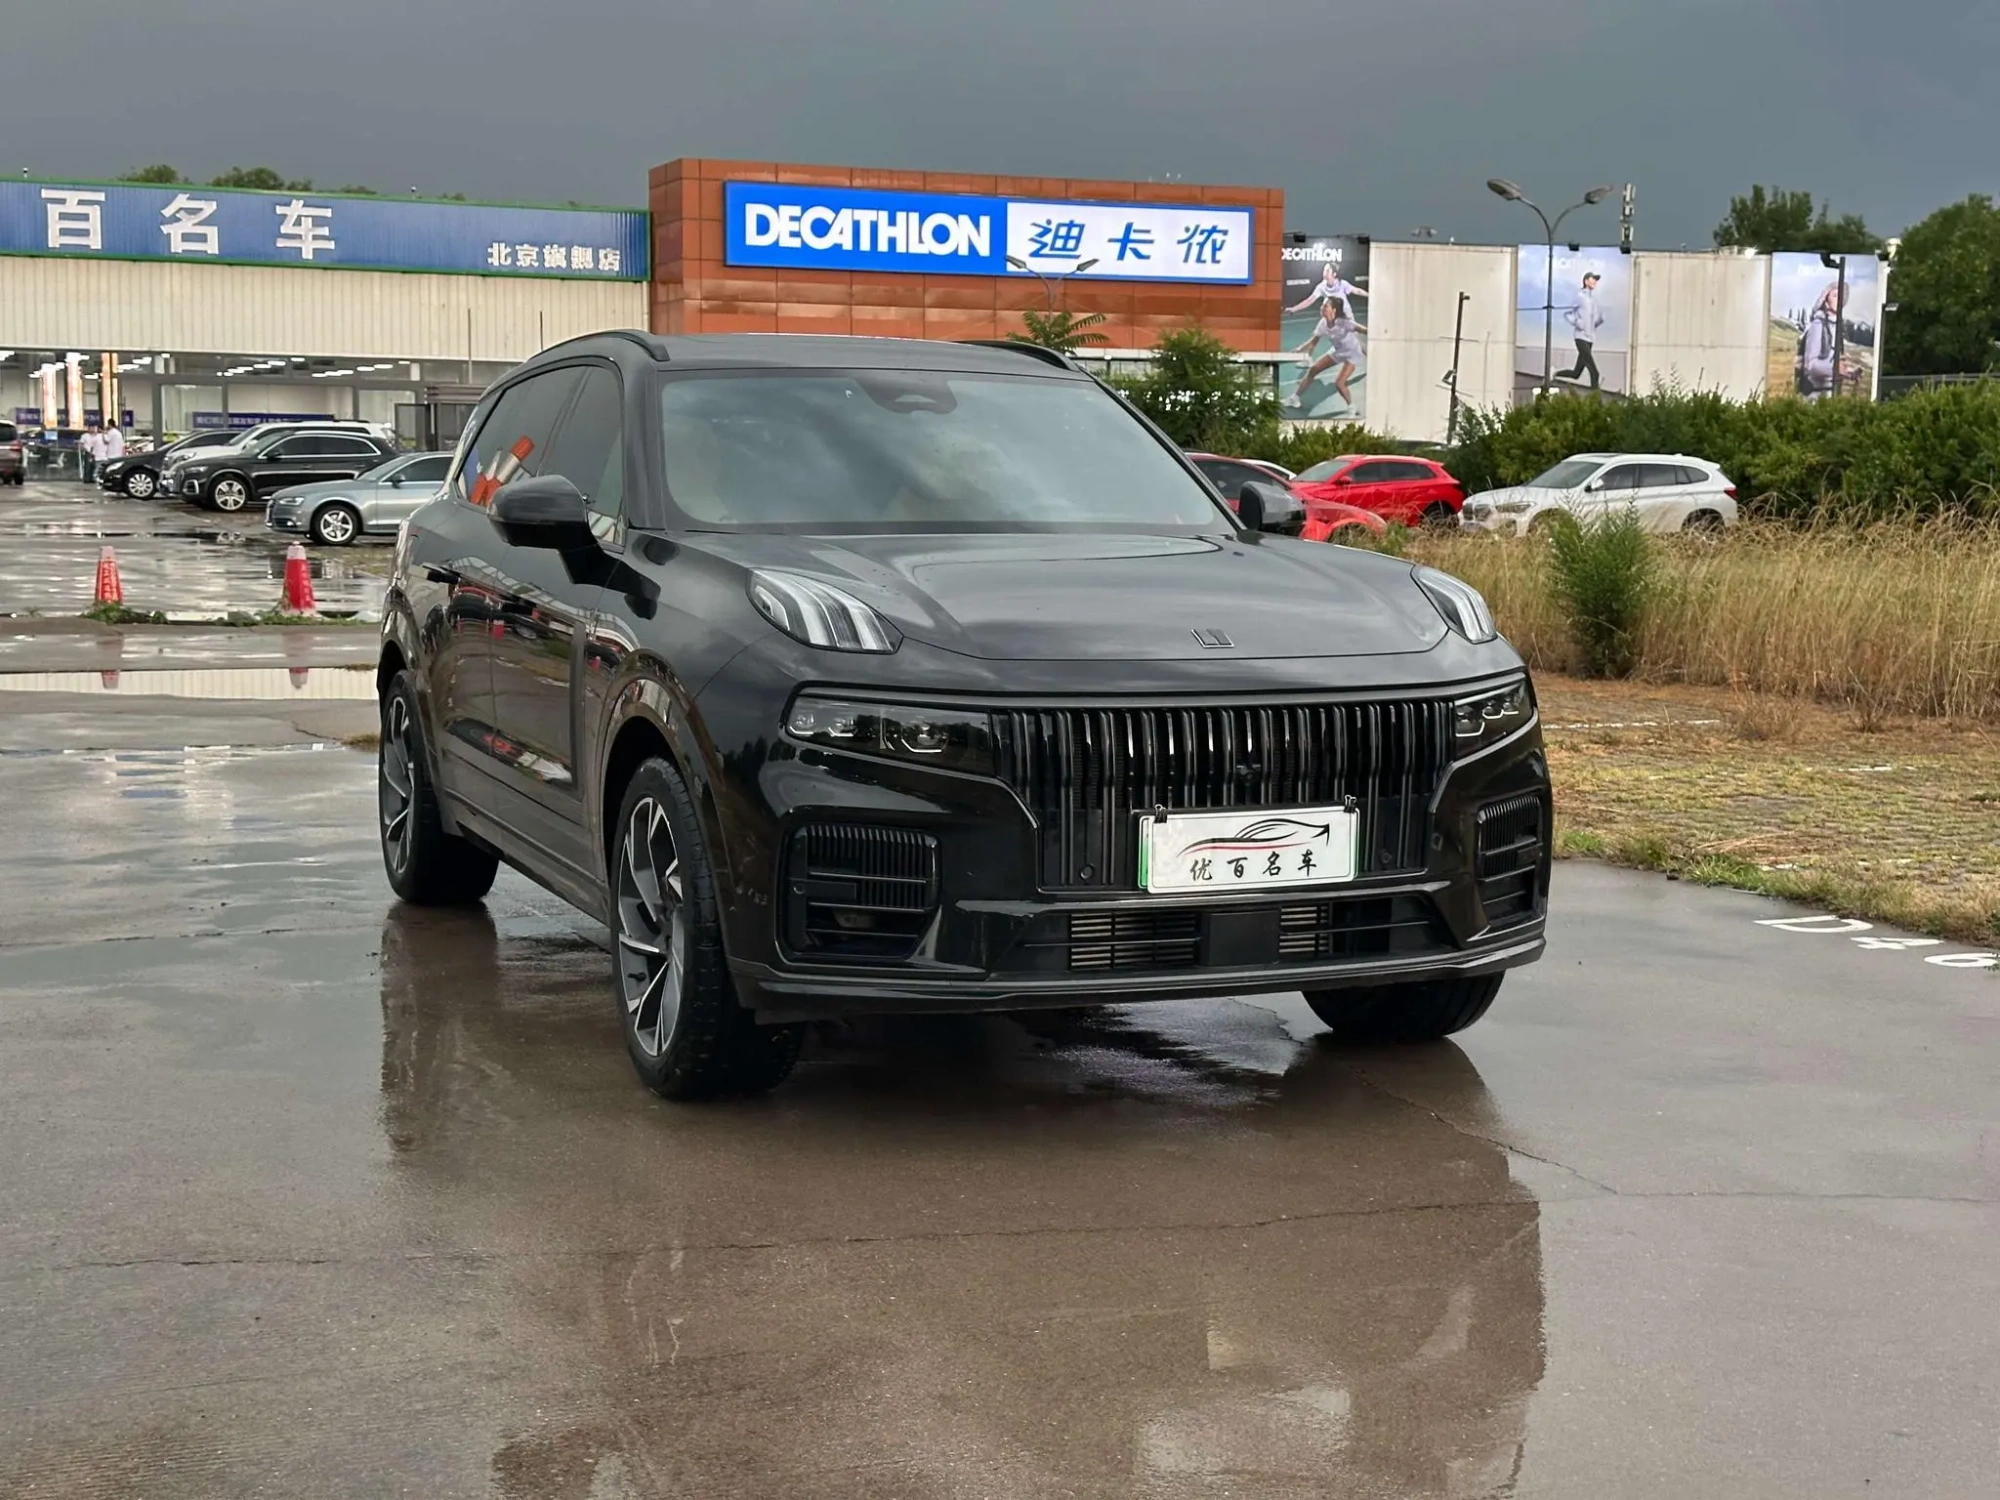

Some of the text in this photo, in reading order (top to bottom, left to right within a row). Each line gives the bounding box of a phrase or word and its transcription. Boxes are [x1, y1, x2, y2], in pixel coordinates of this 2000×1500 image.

[41, 188, 336, 260] 百名车
[745, 203, 991, 257] DECATHLON
[1028, 219, 1229, 264] 迪卡侬
[487, 242, 621, 271] 北京旗舰店
[1190, 849, 1317, 881] 优百名车
